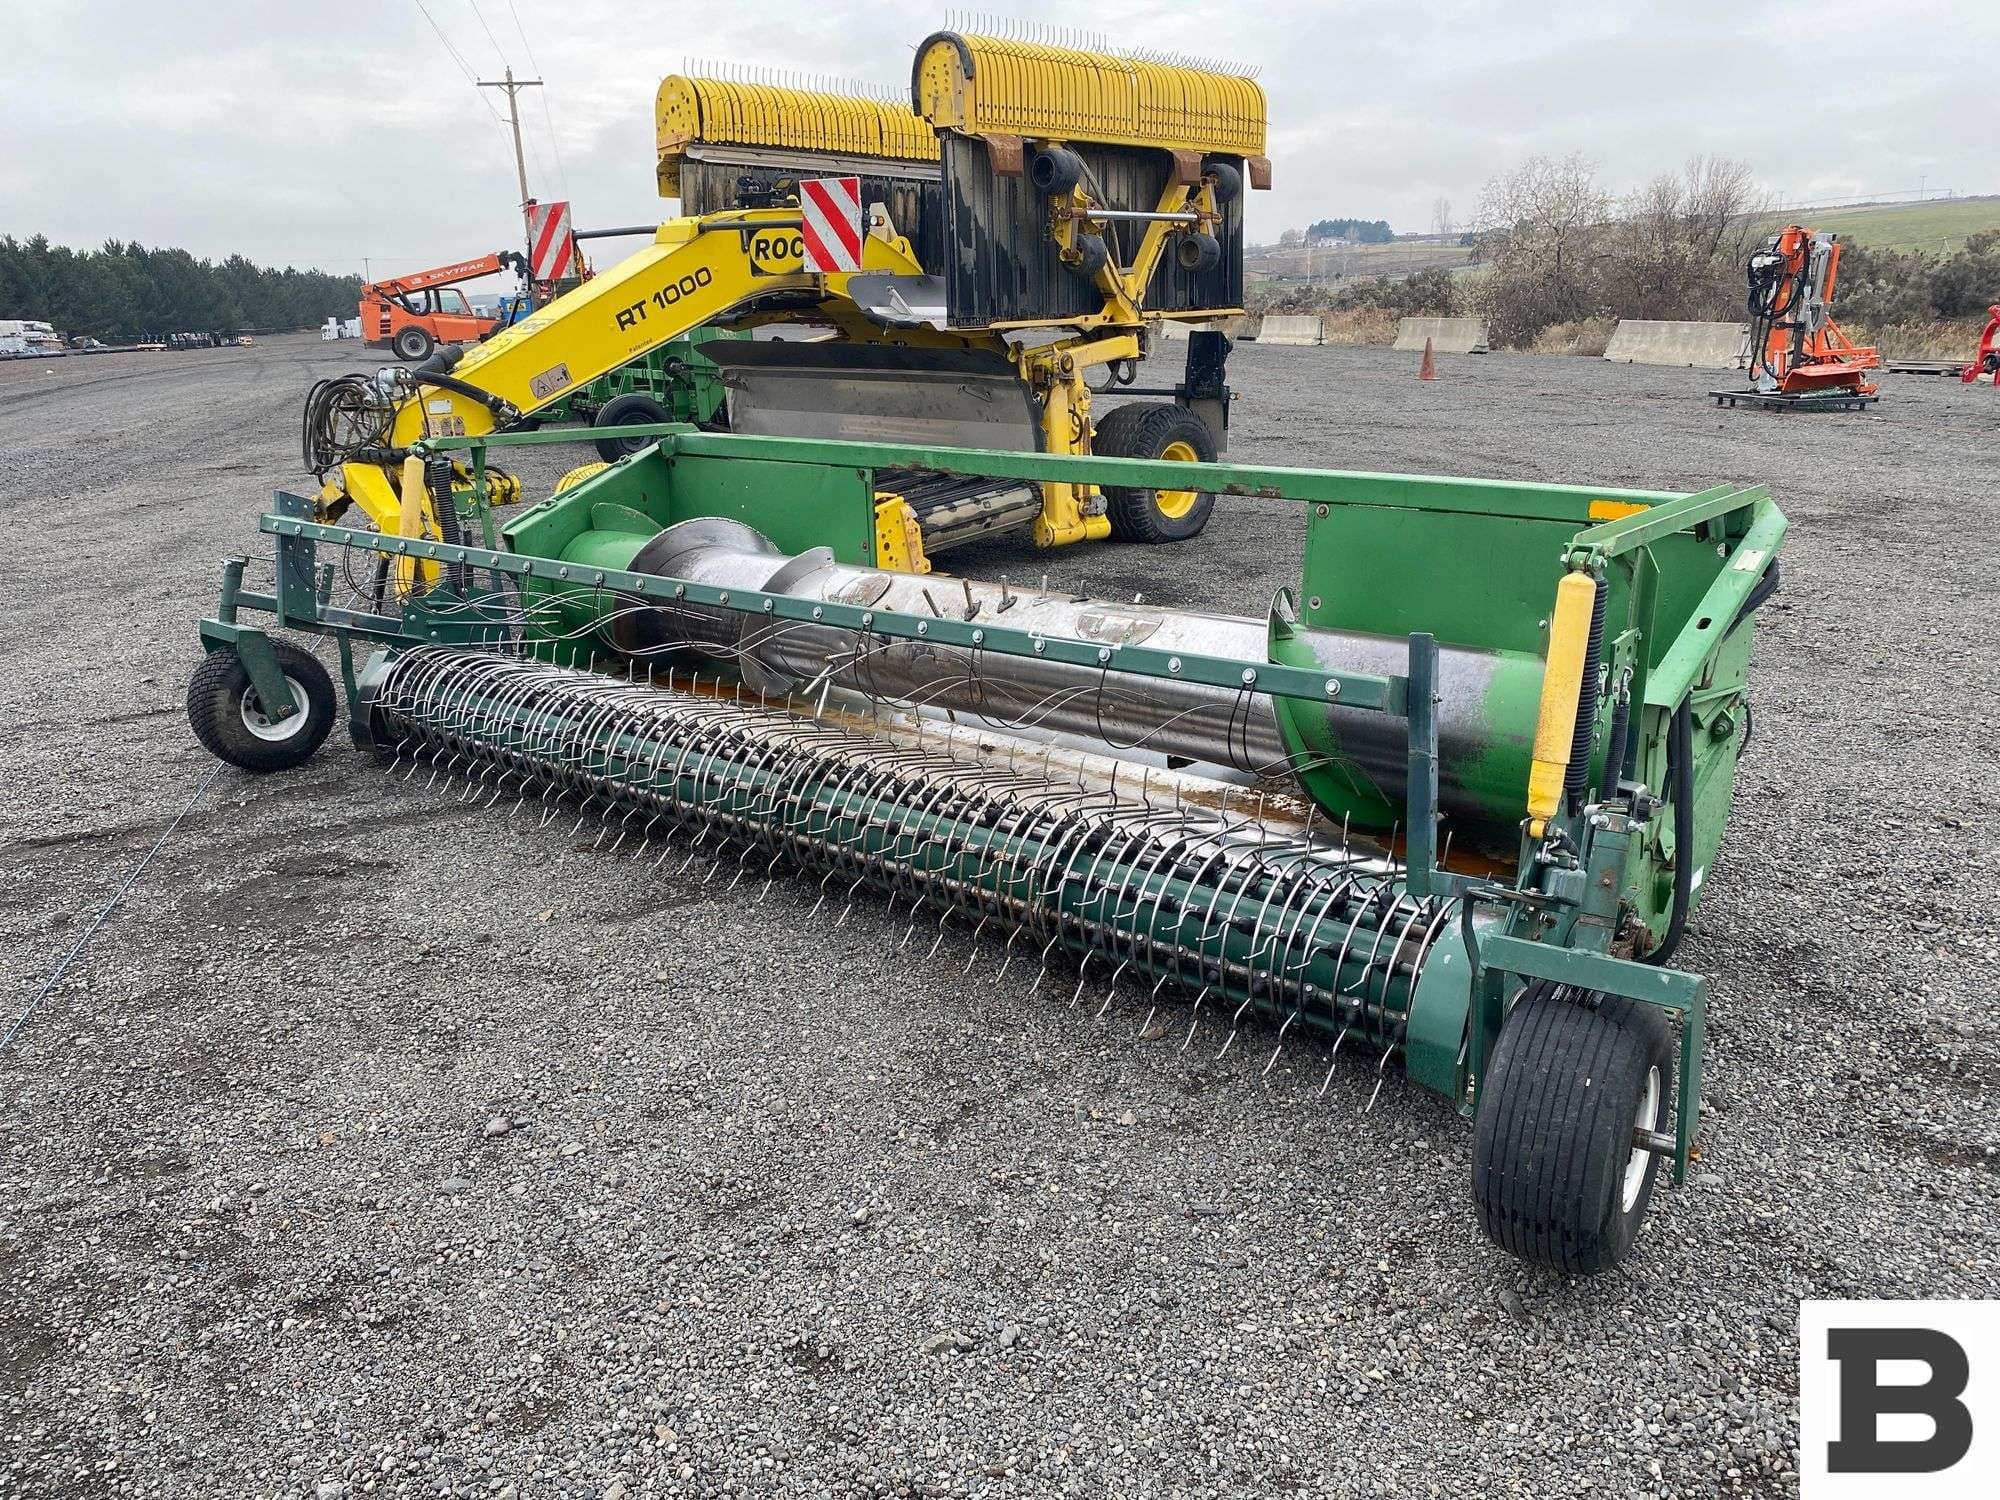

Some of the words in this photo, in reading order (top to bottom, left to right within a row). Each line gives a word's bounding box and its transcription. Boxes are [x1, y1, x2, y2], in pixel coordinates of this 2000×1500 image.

[430, 262, 485, 279] SKYTRAK
[615, 299, 647, 332] RT
[652, 266, 713, 309] 1000
